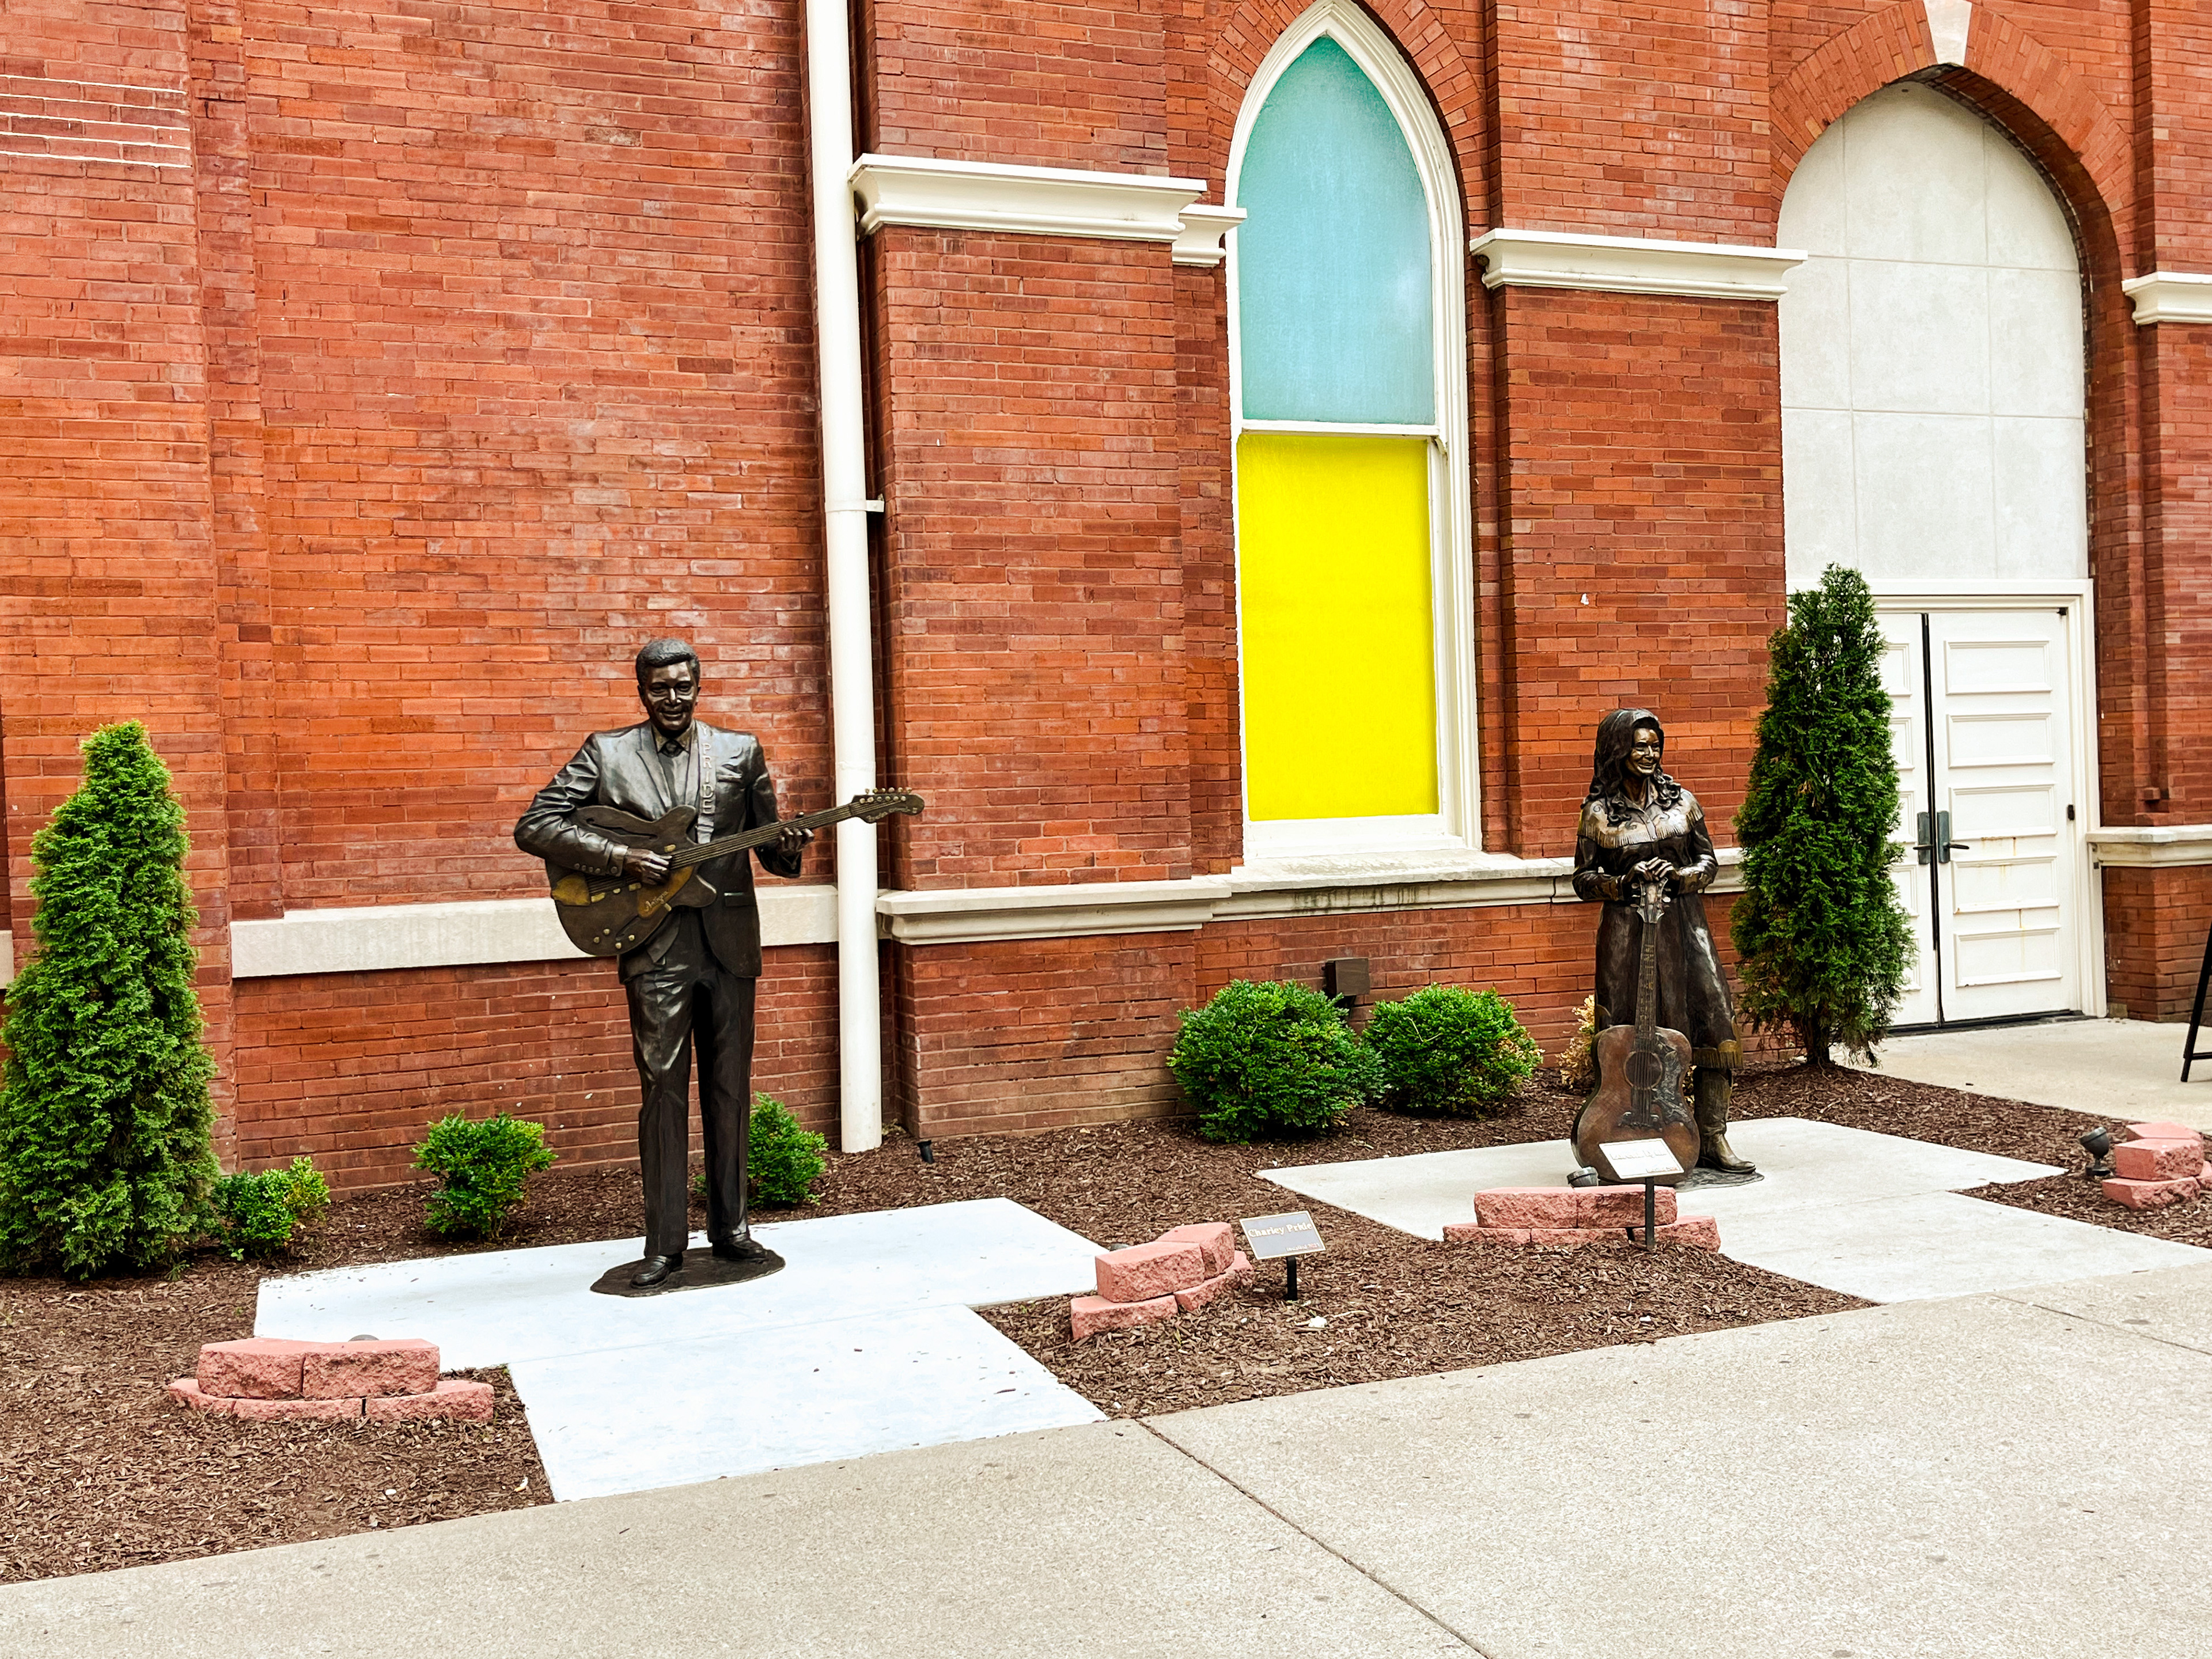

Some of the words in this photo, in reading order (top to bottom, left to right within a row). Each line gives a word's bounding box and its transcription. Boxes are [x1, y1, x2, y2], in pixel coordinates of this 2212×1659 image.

[702, 743, 715, 815] PRIDE
[1248, 1226, 1285, 1237] Charley
[1286, 1222, 1313, 1232] Pride
